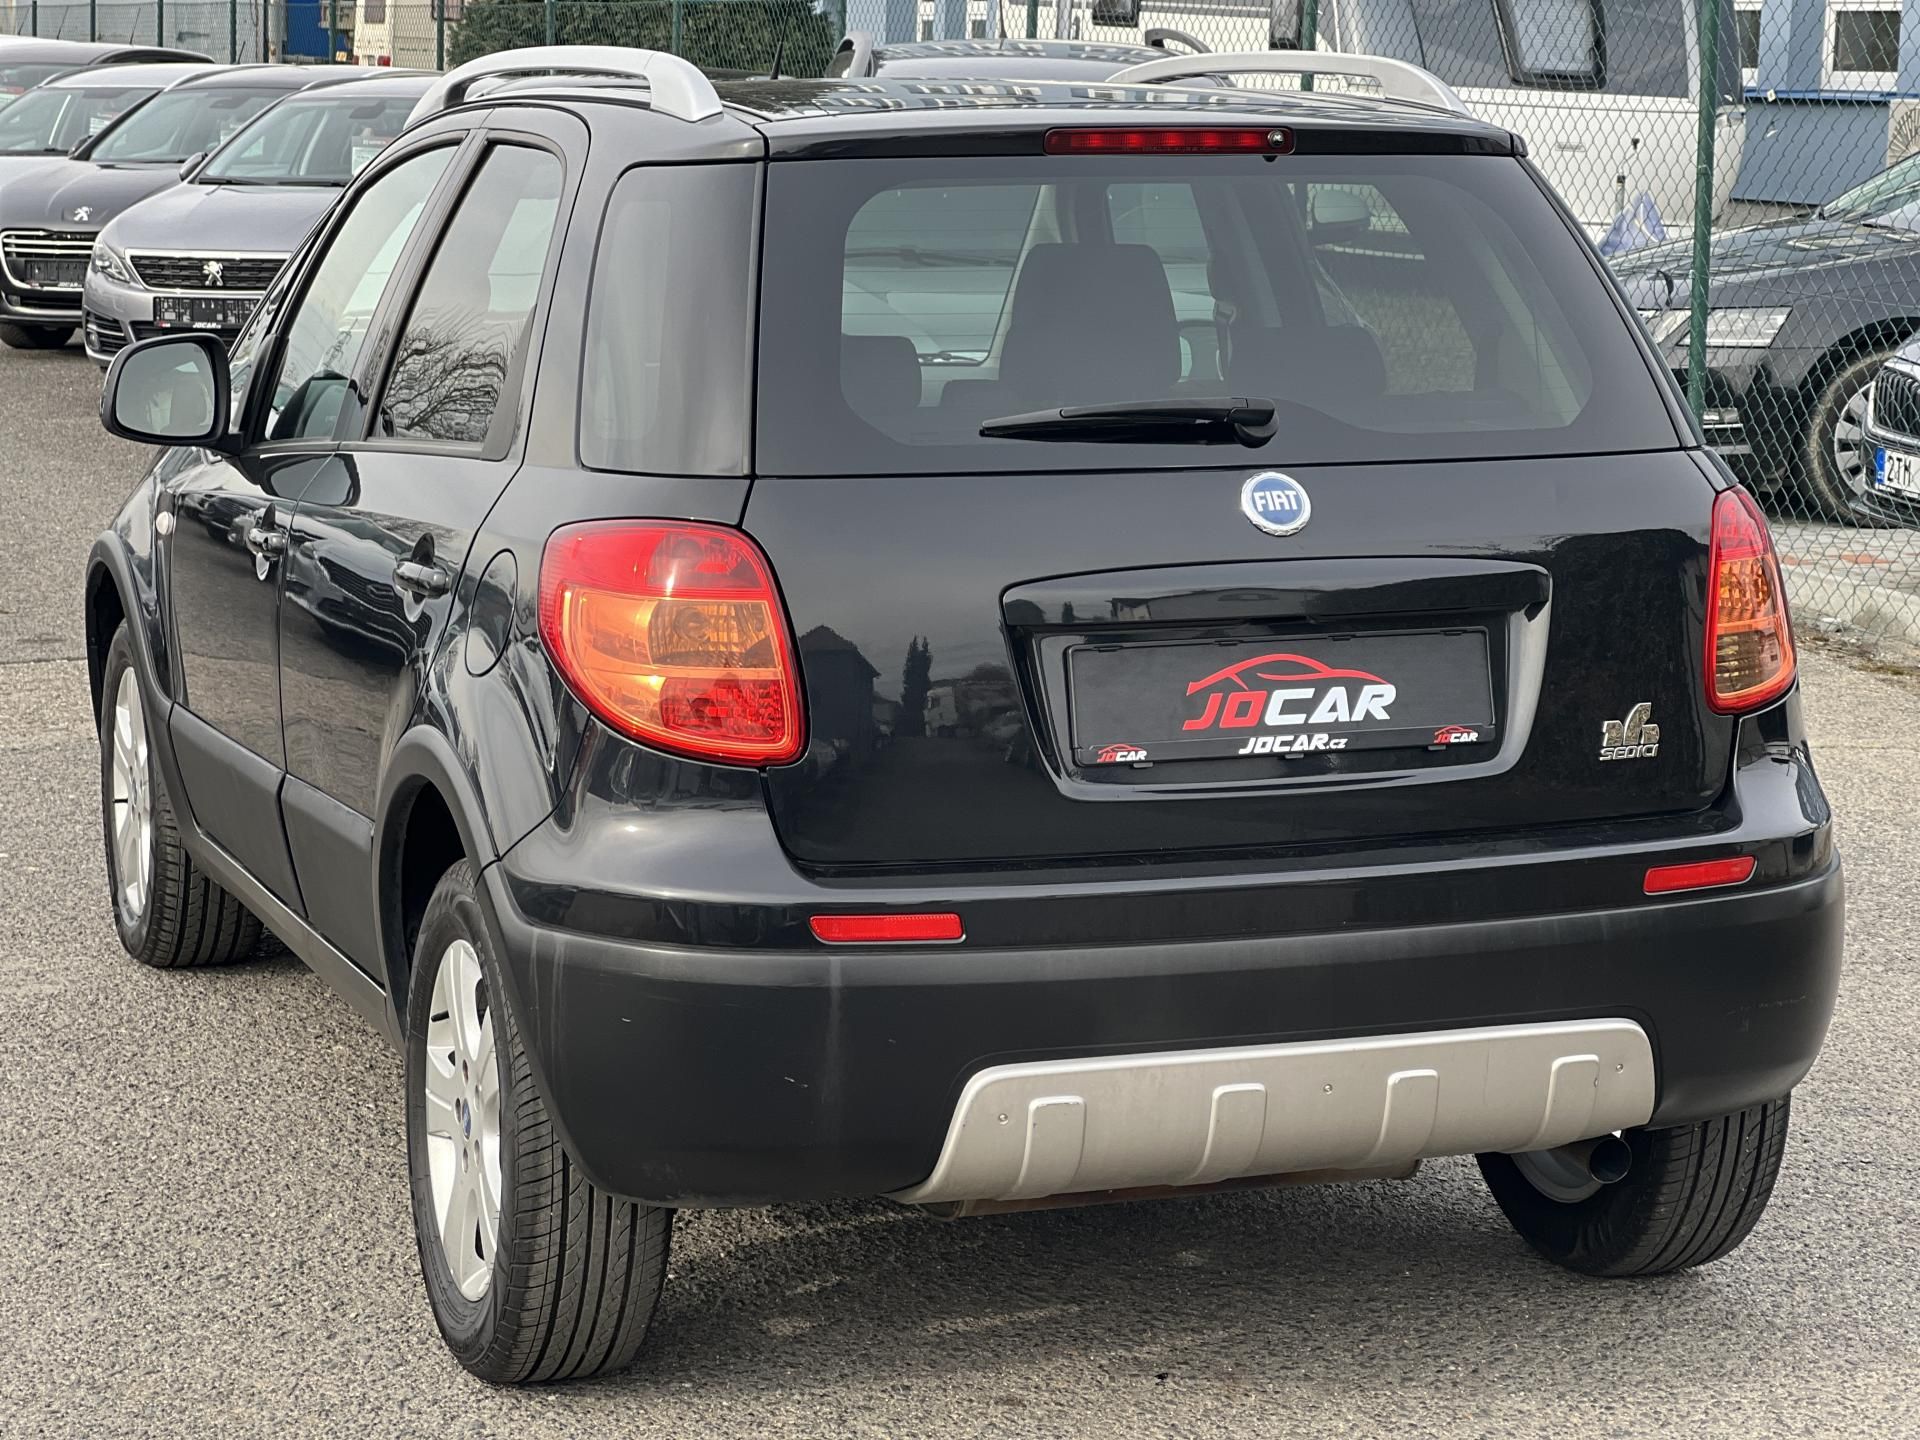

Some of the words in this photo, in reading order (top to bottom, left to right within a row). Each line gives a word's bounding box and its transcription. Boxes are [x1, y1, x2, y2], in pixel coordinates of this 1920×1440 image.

[1253, 489, 1298, 512] FIAT
[1182, 683, 1397, 731] JOCAR
[1238, 733, 1347, 755] JOCAR.cz
[1433, 731, 1479, 744] JOCAR
[1097, 750, 1148, 764] JOCAR
[1599, 743, 1659, 761] SEDICI
